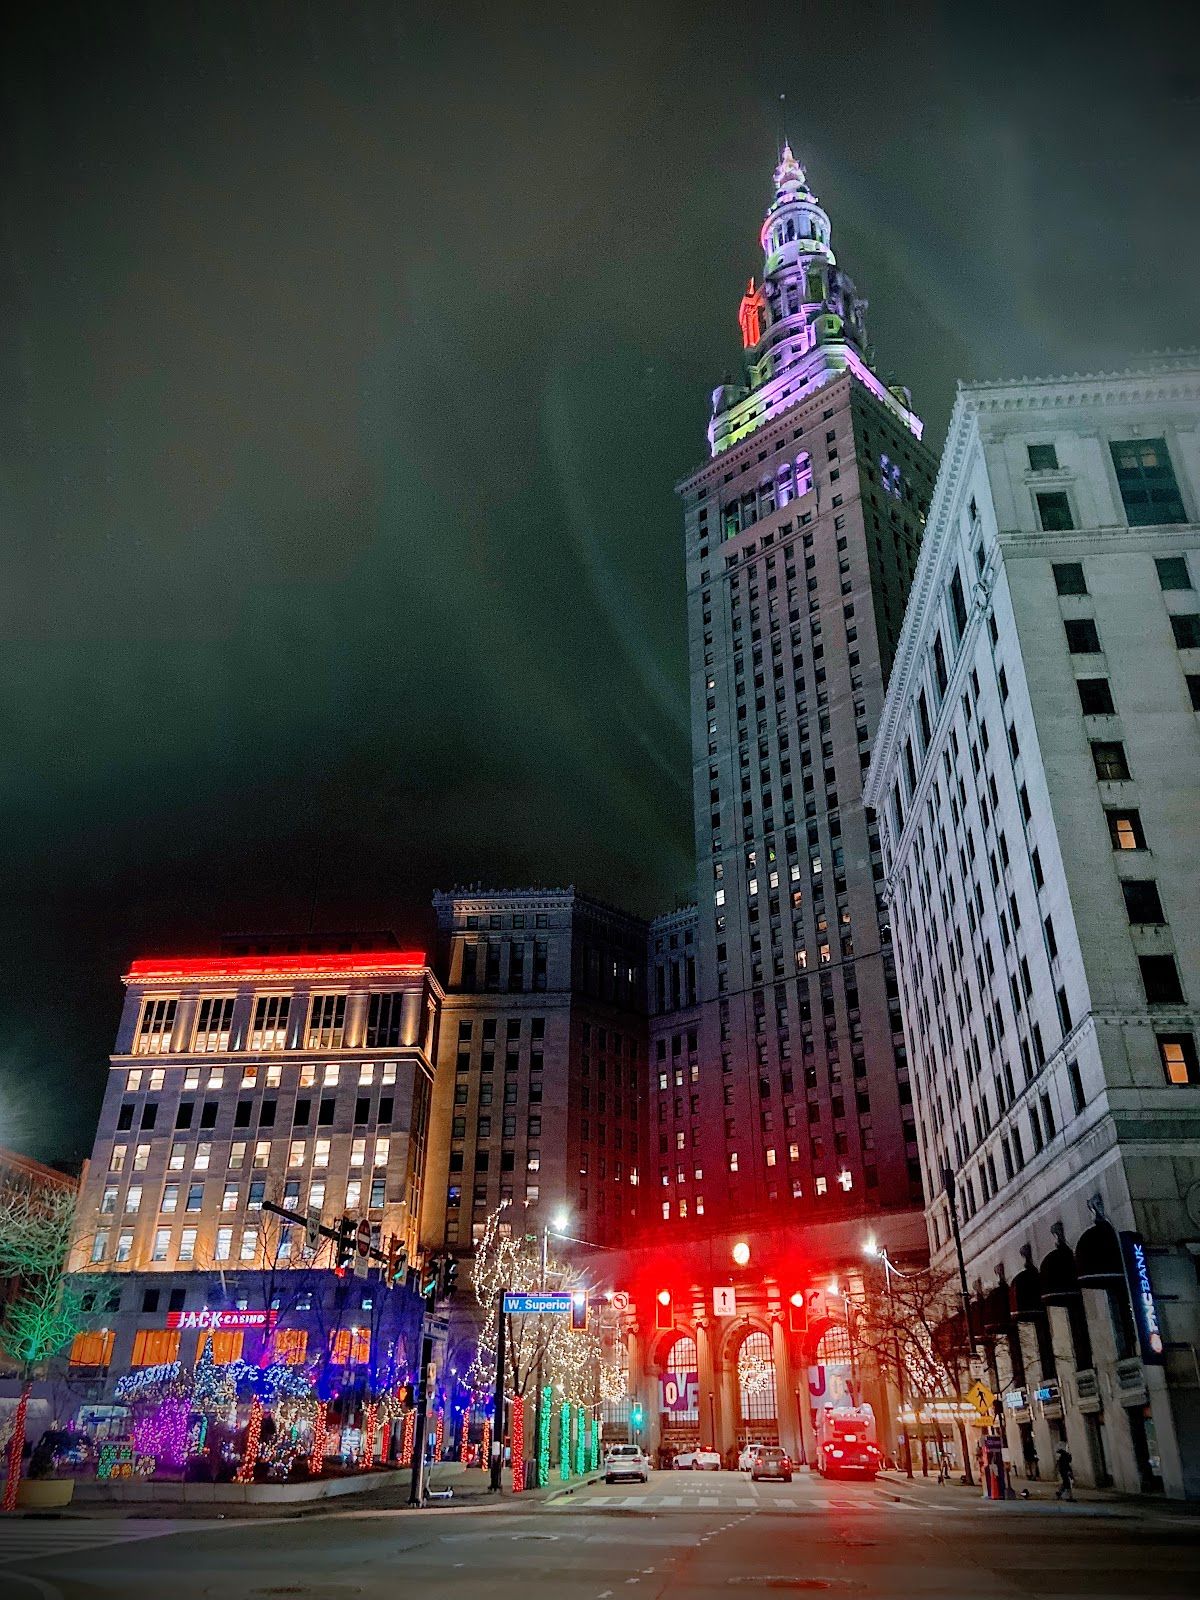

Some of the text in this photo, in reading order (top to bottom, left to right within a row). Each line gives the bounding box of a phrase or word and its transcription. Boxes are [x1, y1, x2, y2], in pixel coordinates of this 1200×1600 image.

[507, 1299, 570, 1312] W. Superior
[223, 1314, 266, 1324] CASINO
[658, 1372, 699, 1413] LOVE
